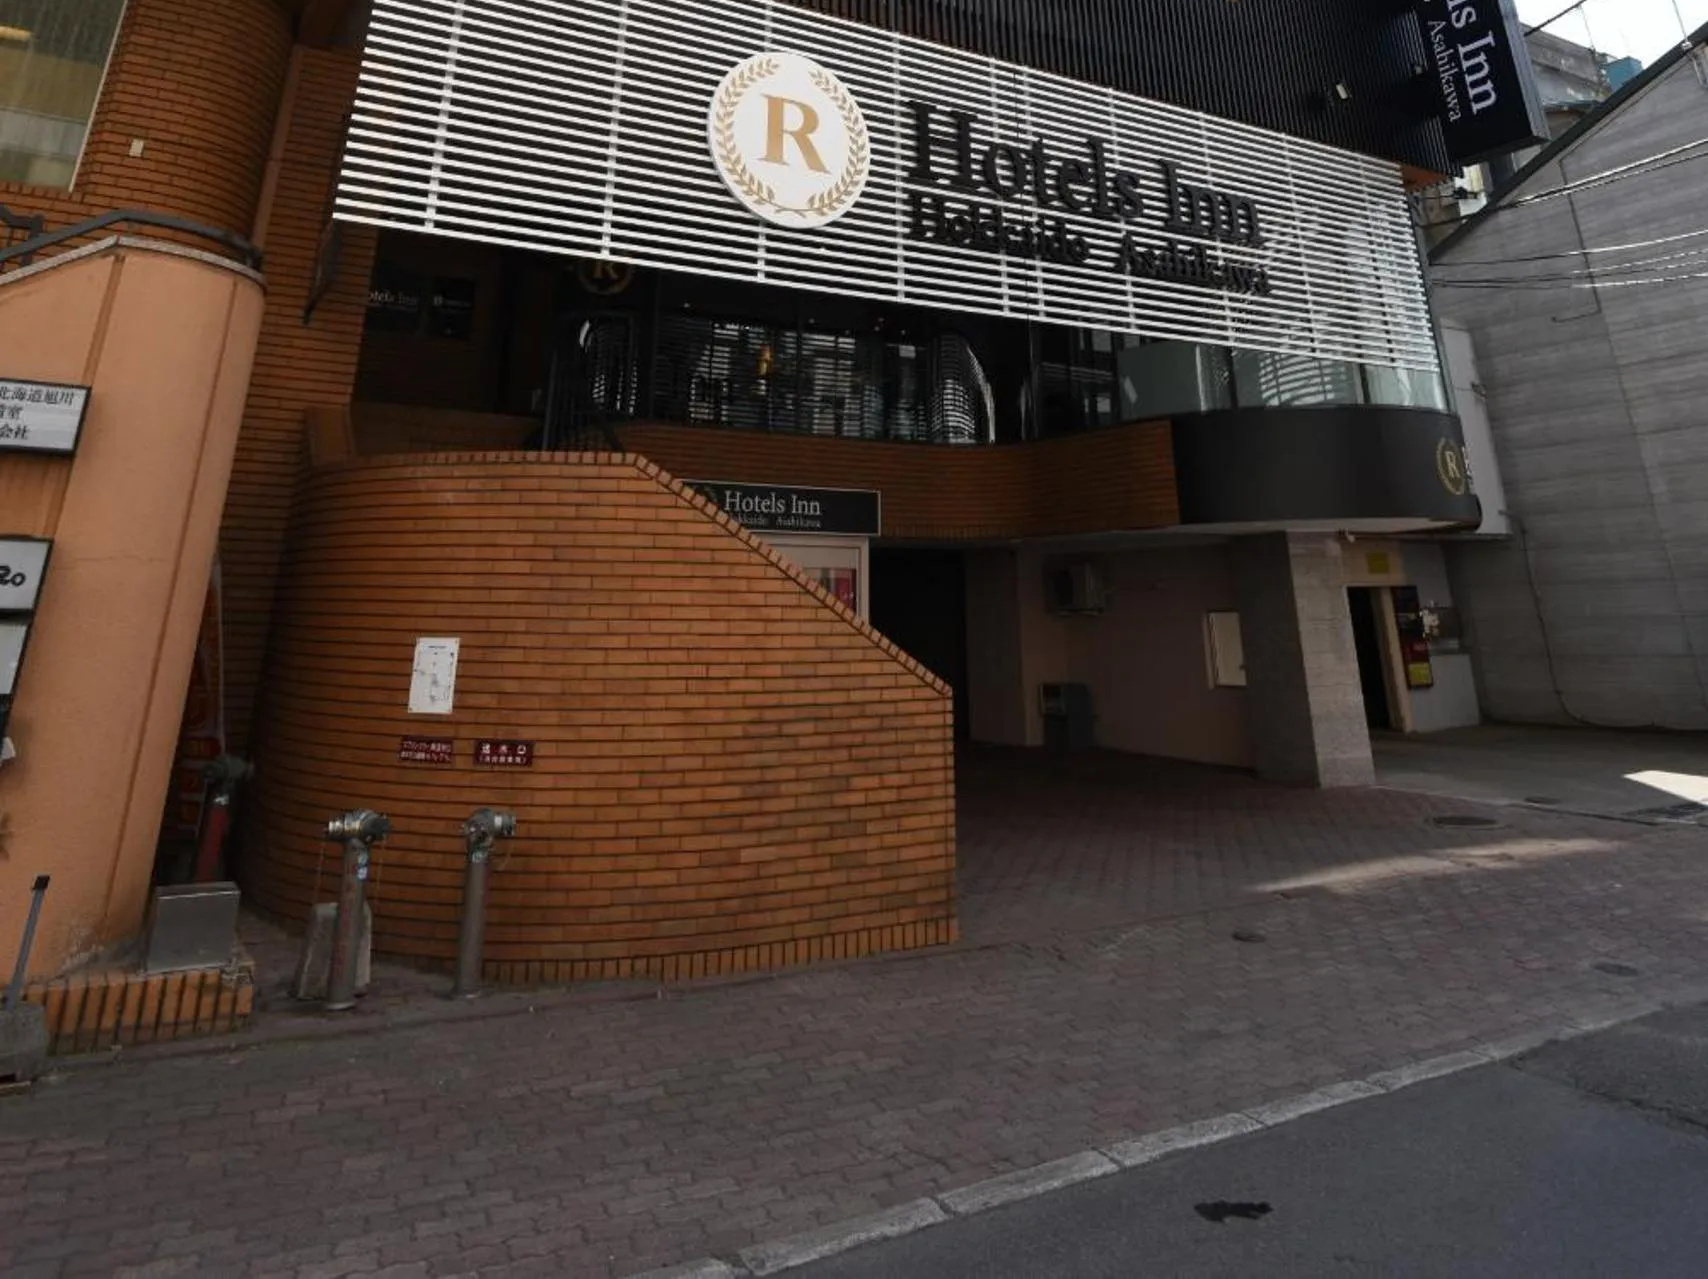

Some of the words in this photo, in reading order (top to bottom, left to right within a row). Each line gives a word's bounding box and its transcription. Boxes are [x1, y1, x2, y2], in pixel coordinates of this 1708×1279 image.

[1428, 20, 1461, 122] Asahikawa
[1457, 31, 1497, 114] Inn
[761, 94, 830, 173] R
[905, 100, 1143, 220] Hotels
[1159, 158, 1266, 249] Inn
[906, 192, 1089, 264] Hokkaido
[724, 490, 786, 514] Hotels
[791, 494, 821, 516] Inn
